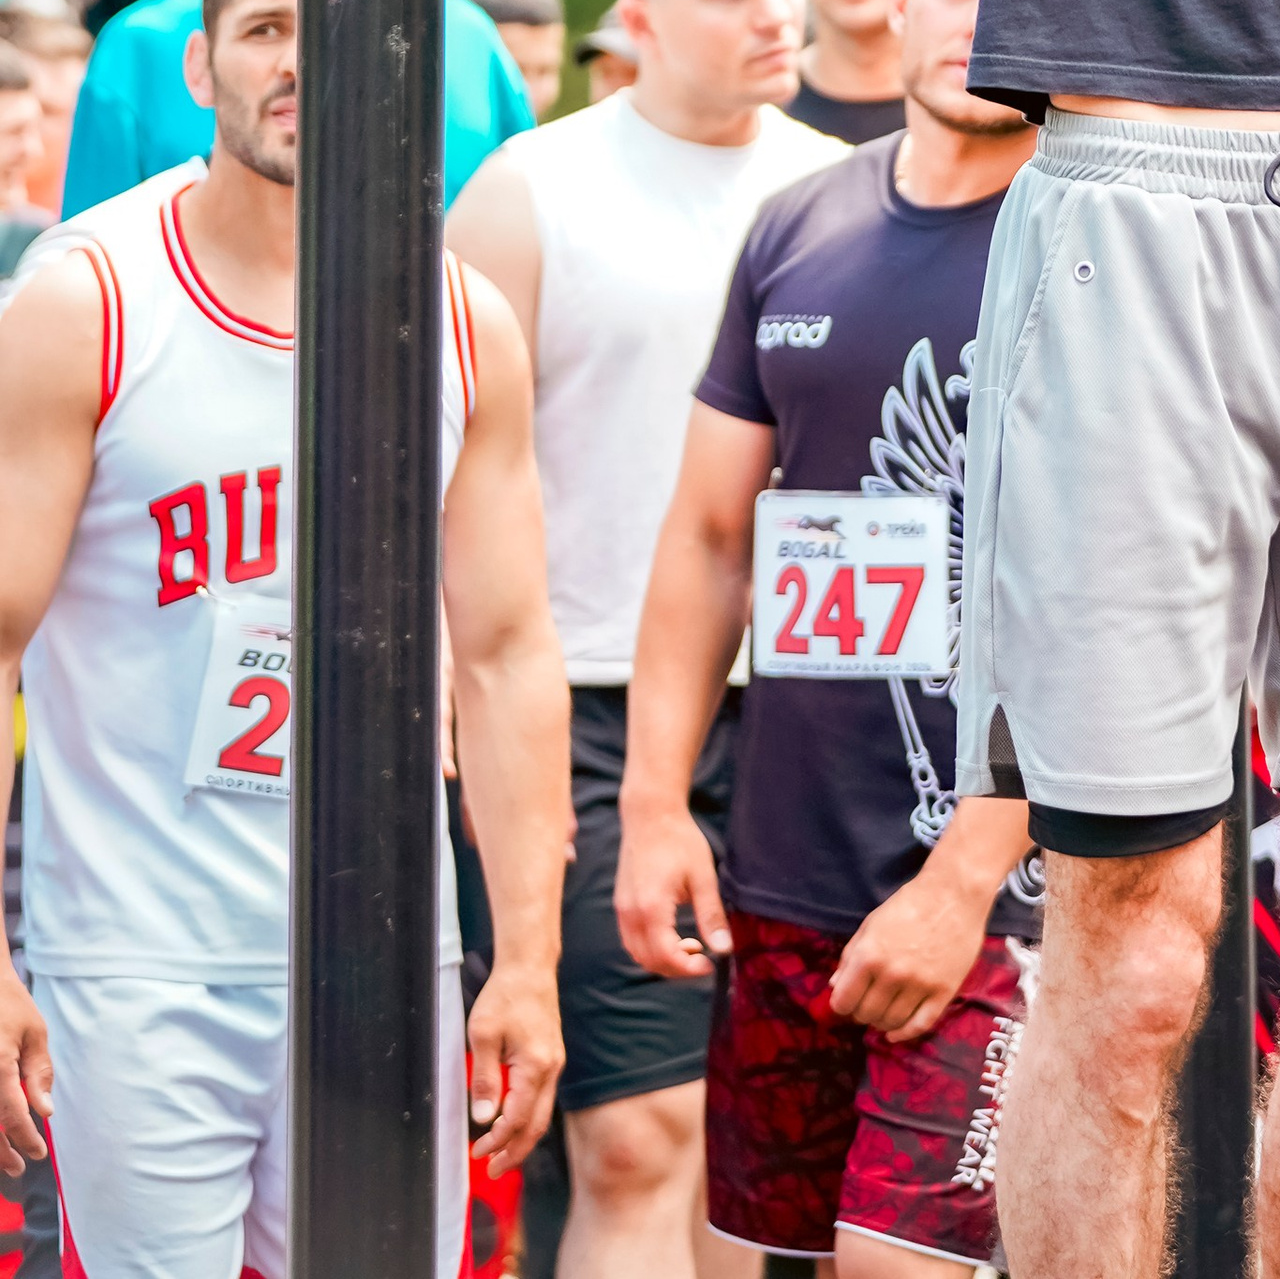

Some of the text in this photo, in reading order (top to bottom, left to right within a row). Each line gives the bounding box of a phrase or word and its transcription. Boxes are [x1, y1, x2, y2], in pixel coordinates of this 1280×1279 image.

[149, 465, 282, 607] BU
[777, 541, 846, 559] BOGAL
[774, 564, 925, 656] 247
[238, 648, 291, 673] BO
[217, 673, 291, 777] 2
[978, 1016, 1013, 1101] FIGHT
[951, 1108, 996, 1185] WEAR
